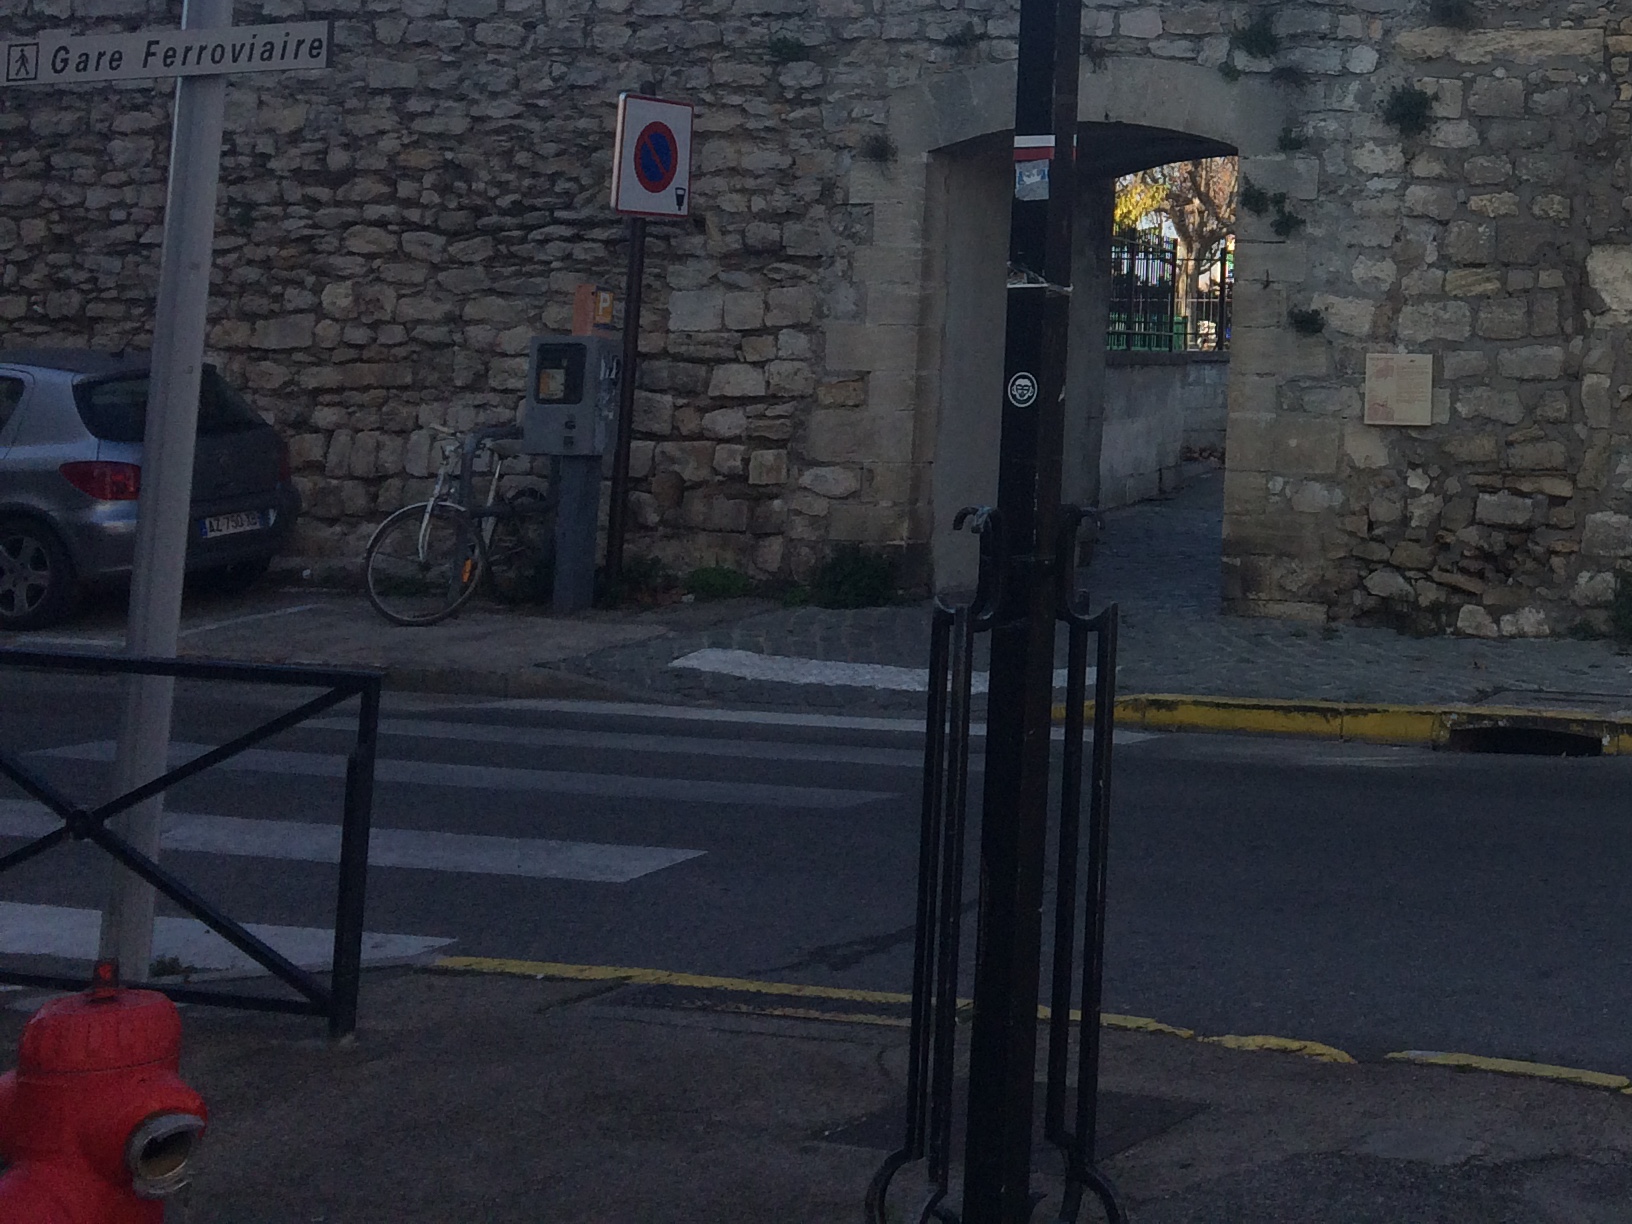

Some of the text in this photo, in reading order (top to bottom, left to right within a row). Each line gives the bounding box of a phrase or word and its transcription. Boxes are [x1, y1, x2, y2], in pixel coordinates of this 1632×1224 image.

[51, 32, 324, 74] Gare Ferroviaire
[598, 293, 610, 314] P
